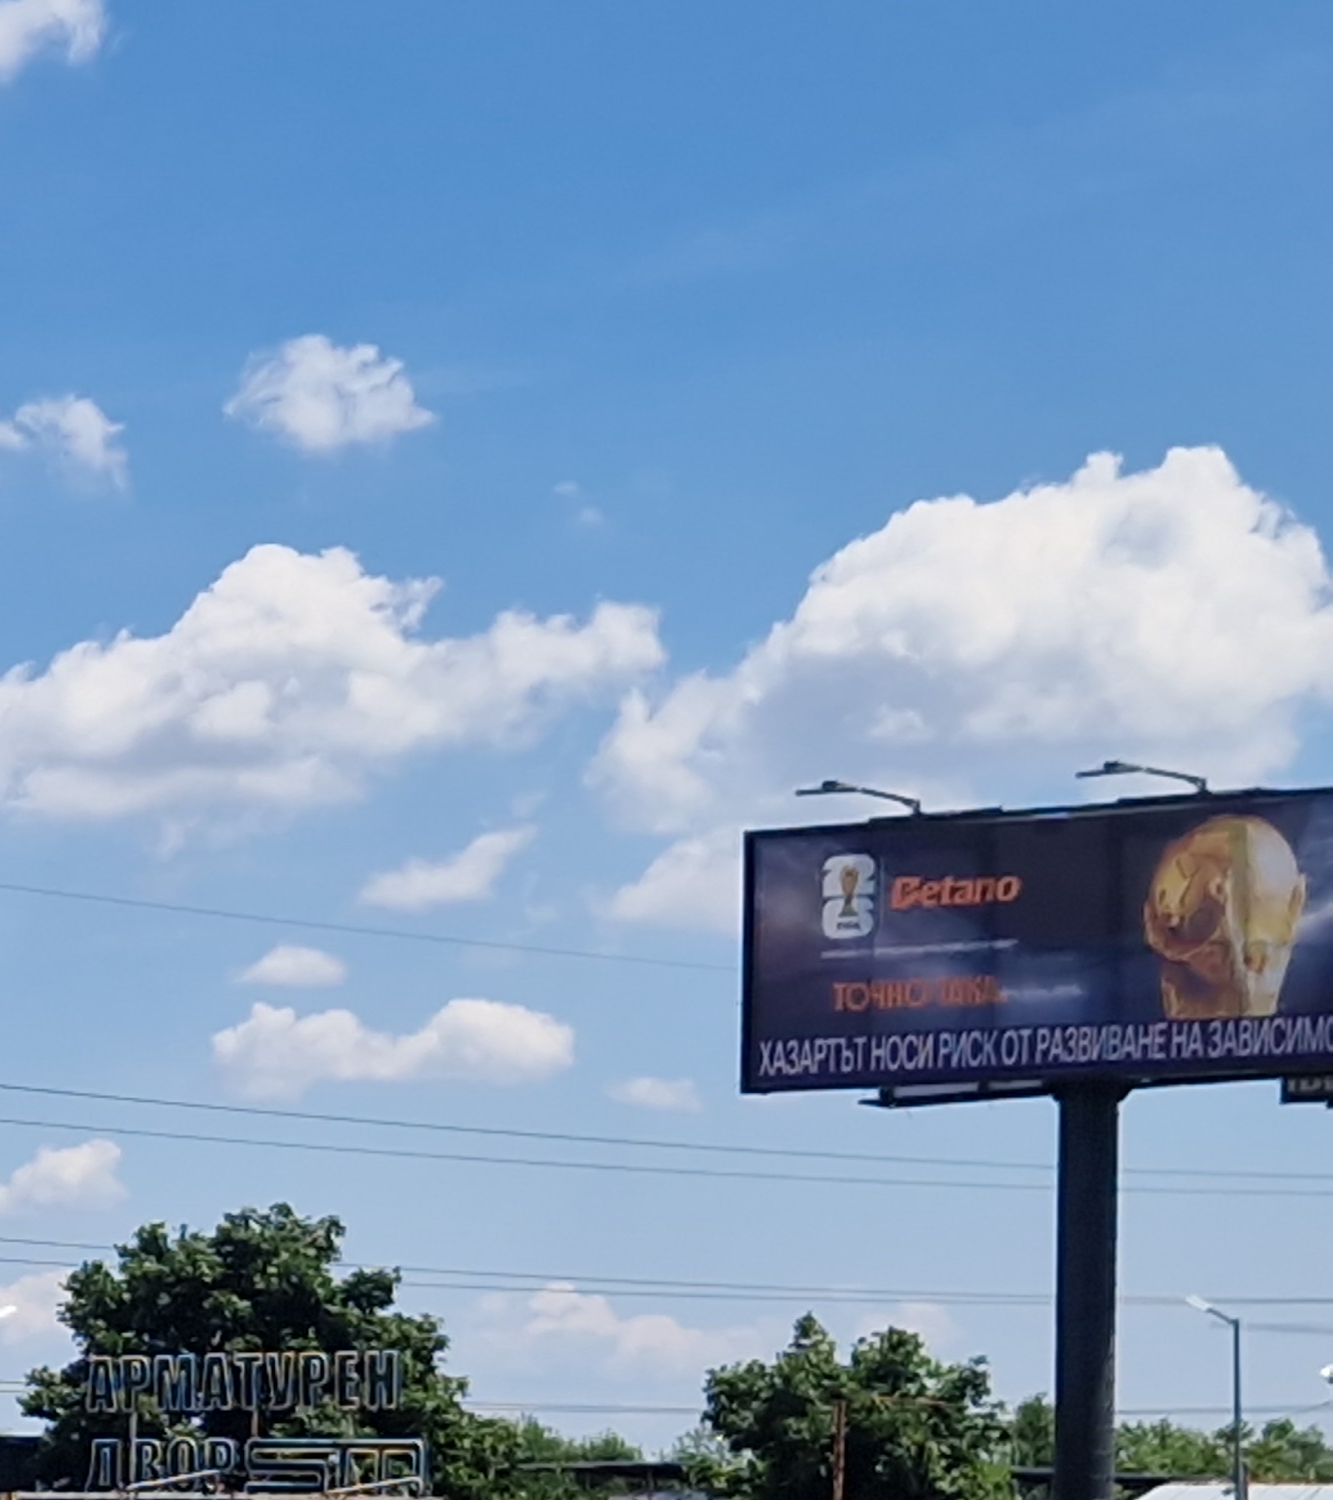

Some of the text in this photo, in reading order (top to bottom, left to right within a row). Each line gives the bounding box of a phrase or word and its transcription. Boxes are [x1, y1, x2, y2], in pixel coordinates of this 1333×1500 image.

[891, 876, 1023, 911] Betano
[759, 1037, 867, 1077] ХАЗАРТЪТ
[871, 1033, 934, 1071] НОСИ
[938, 1029, 999, 1068] РИСК
[1001, 1029, 1035, 1065] ОТ
[1036, 1021, 1168, 1063] РАЗВИВАНЕ
[1172, 1023, 1203, 1059] НА
[86, 1350, 400, 1413] АРМАТУРЕН
[85, 1437, 237, 1492] ДВОР
